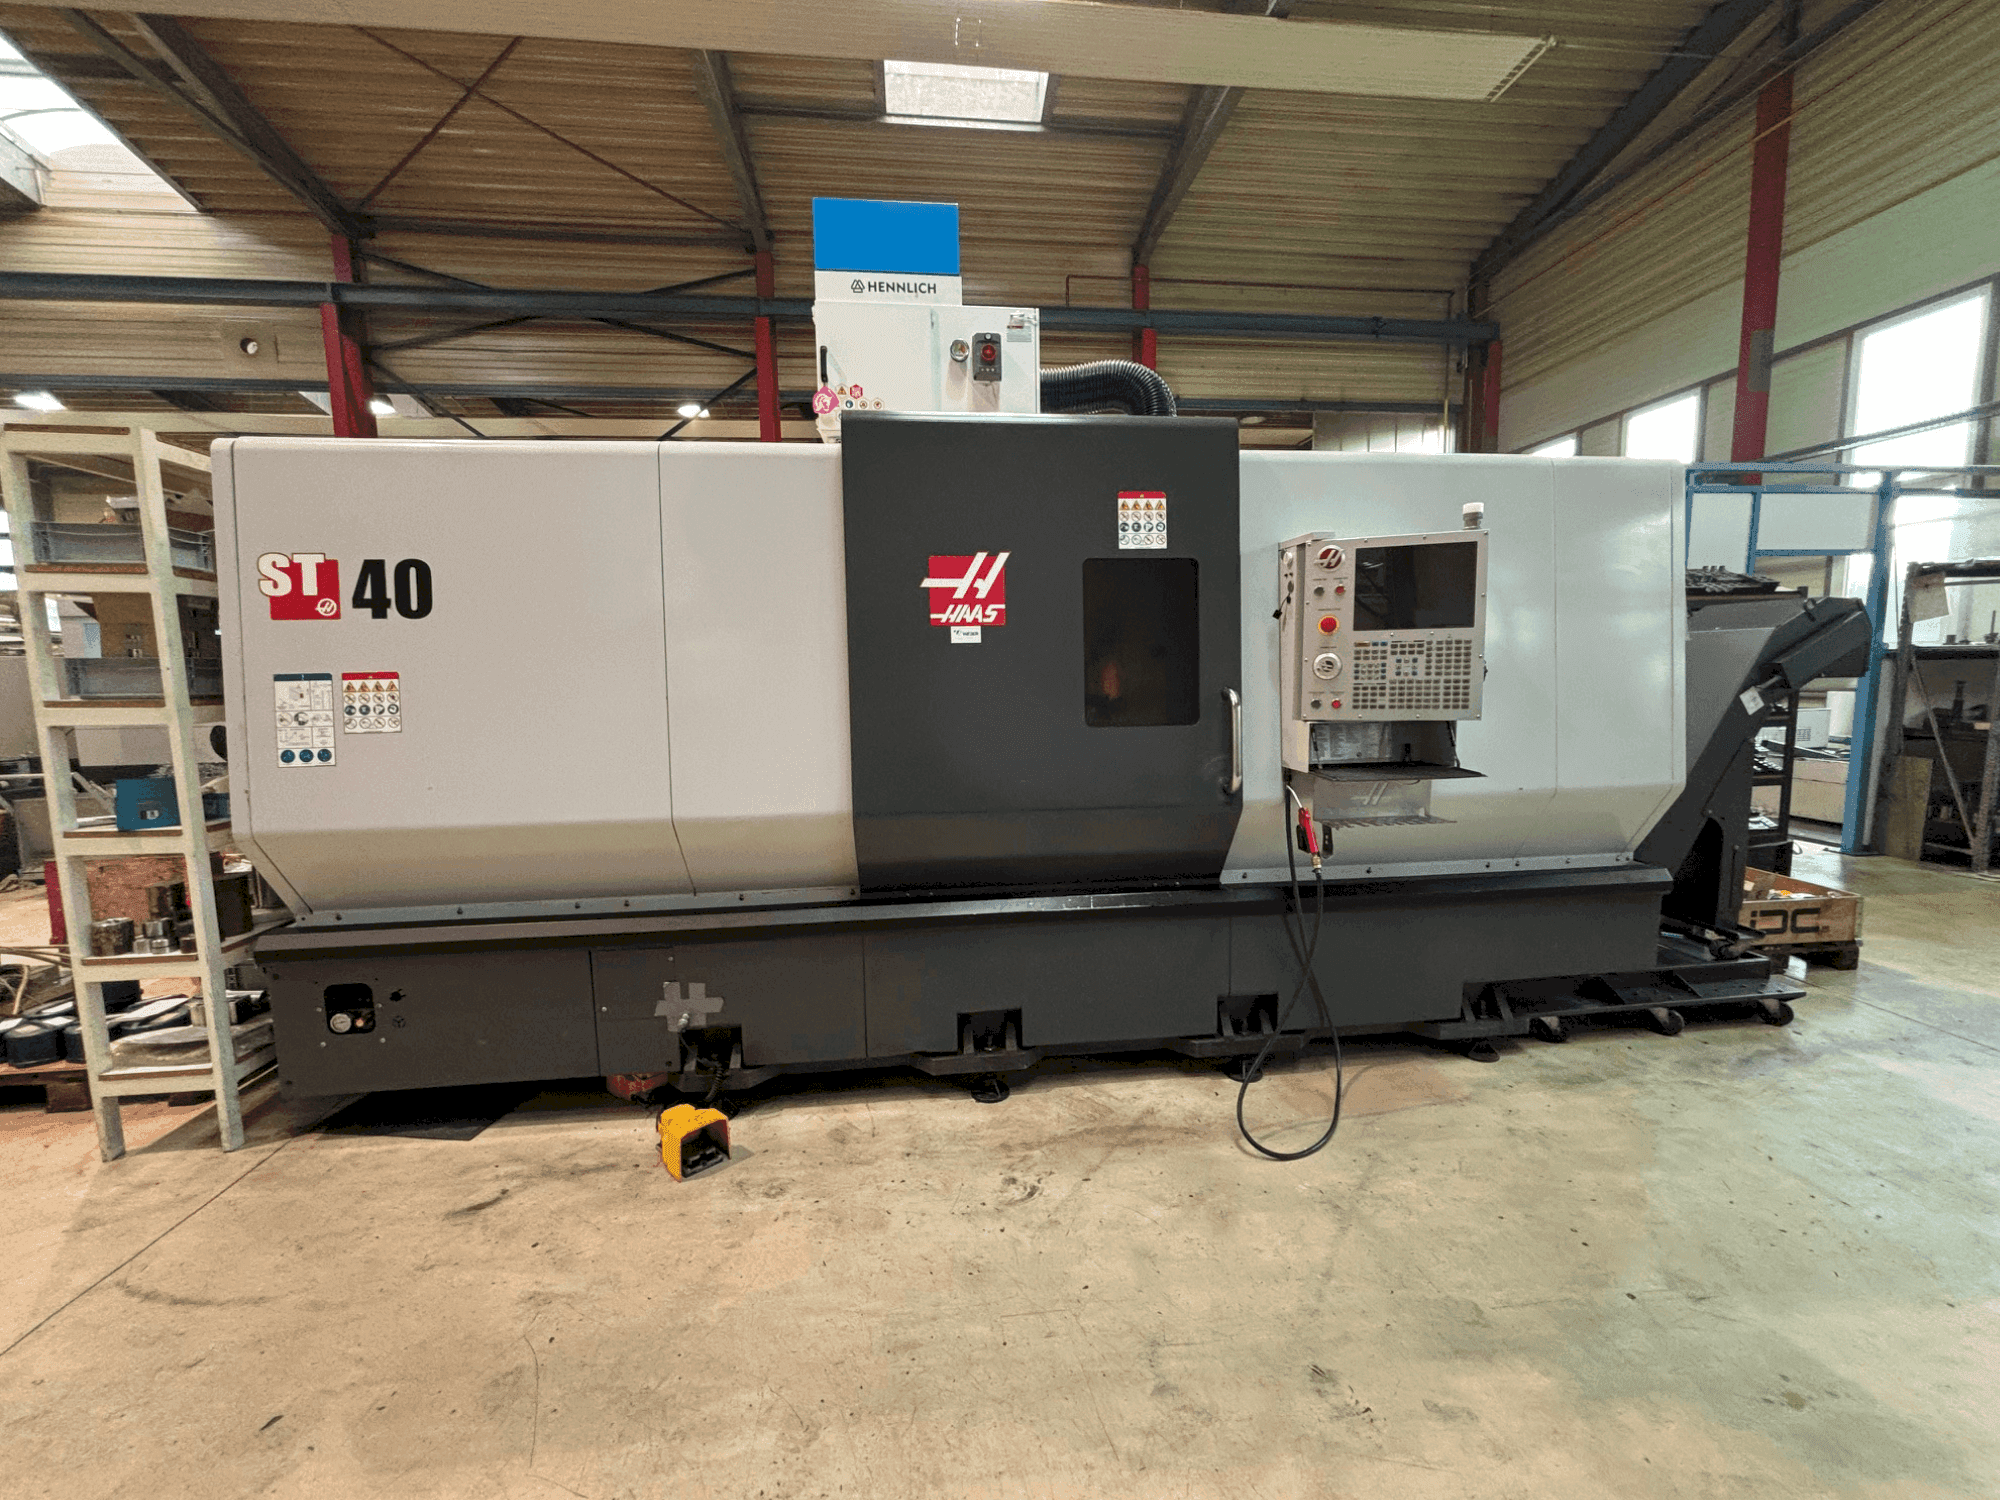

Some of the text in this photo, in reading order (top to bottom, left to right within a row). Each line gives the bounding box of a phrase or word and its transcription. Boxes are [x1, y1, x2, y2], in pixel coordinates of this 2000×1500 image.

[867, 281, 937, 294] HENNLICH
[257, 552, 433, 619] ST 40
[930, 604, 1006, 623] HAAS
